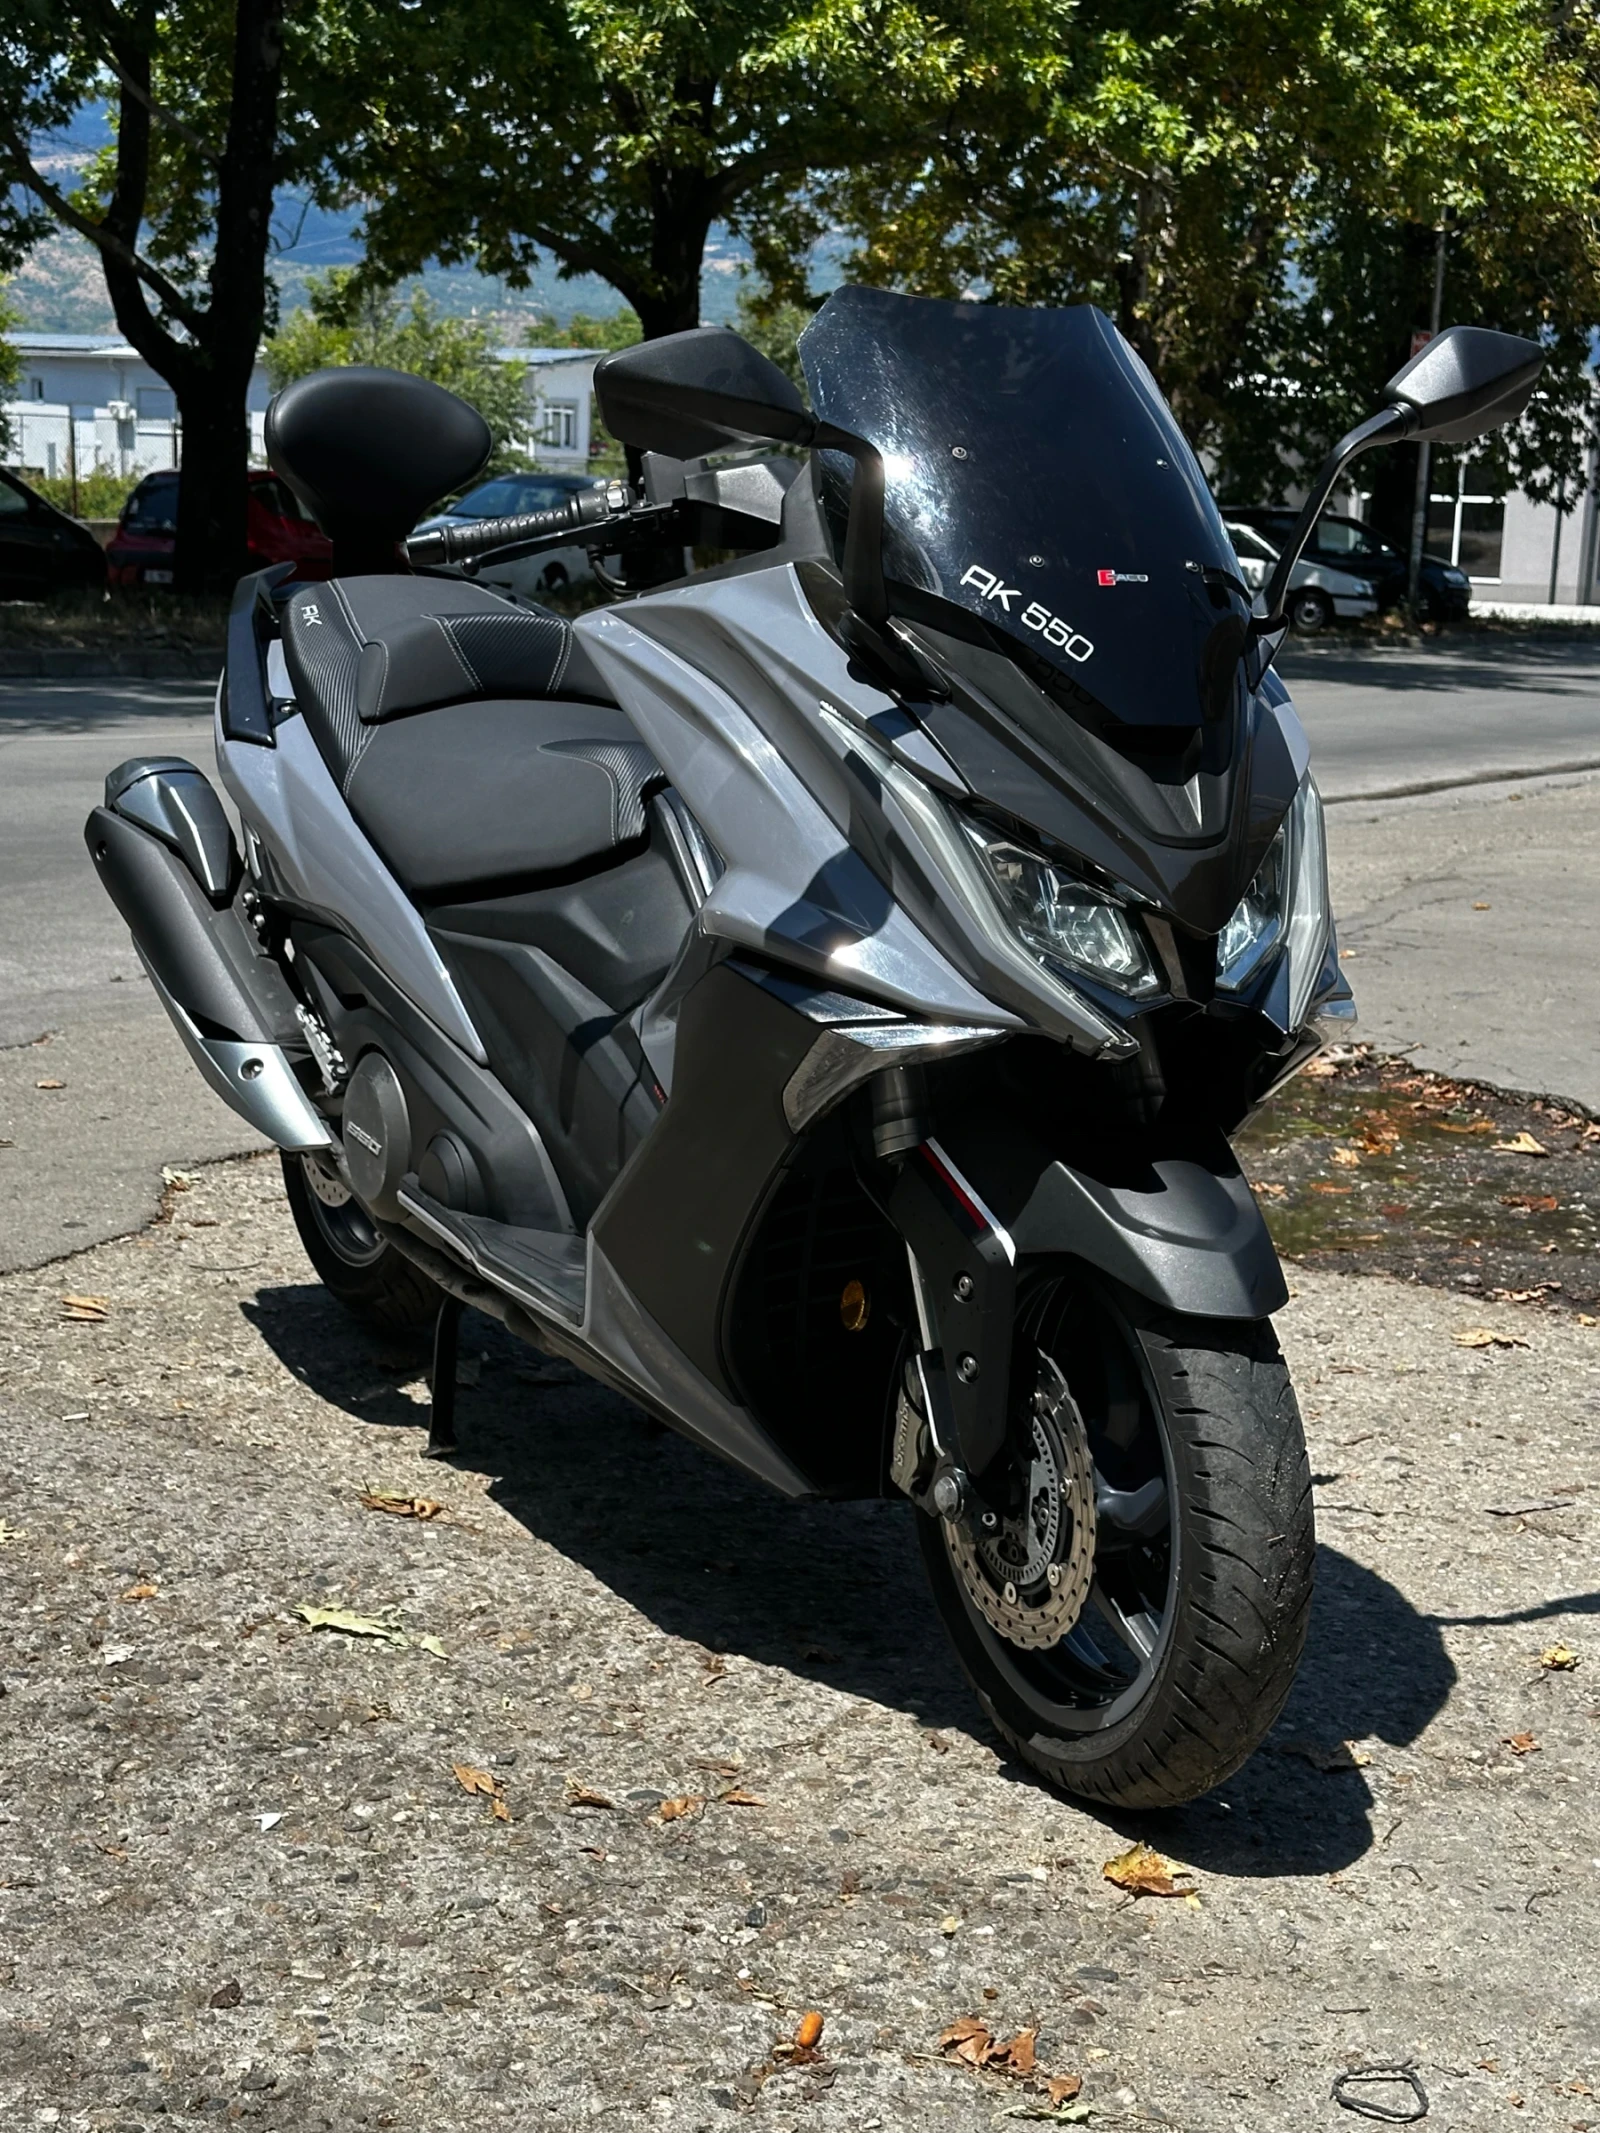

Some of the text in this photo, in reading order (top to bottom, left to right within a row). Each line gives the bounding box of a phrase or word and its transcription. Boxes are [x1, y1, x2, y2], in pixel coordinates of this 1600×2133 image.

[301, 604, 323, 627] AK
[959, 564, 1095, 662] AK 550
